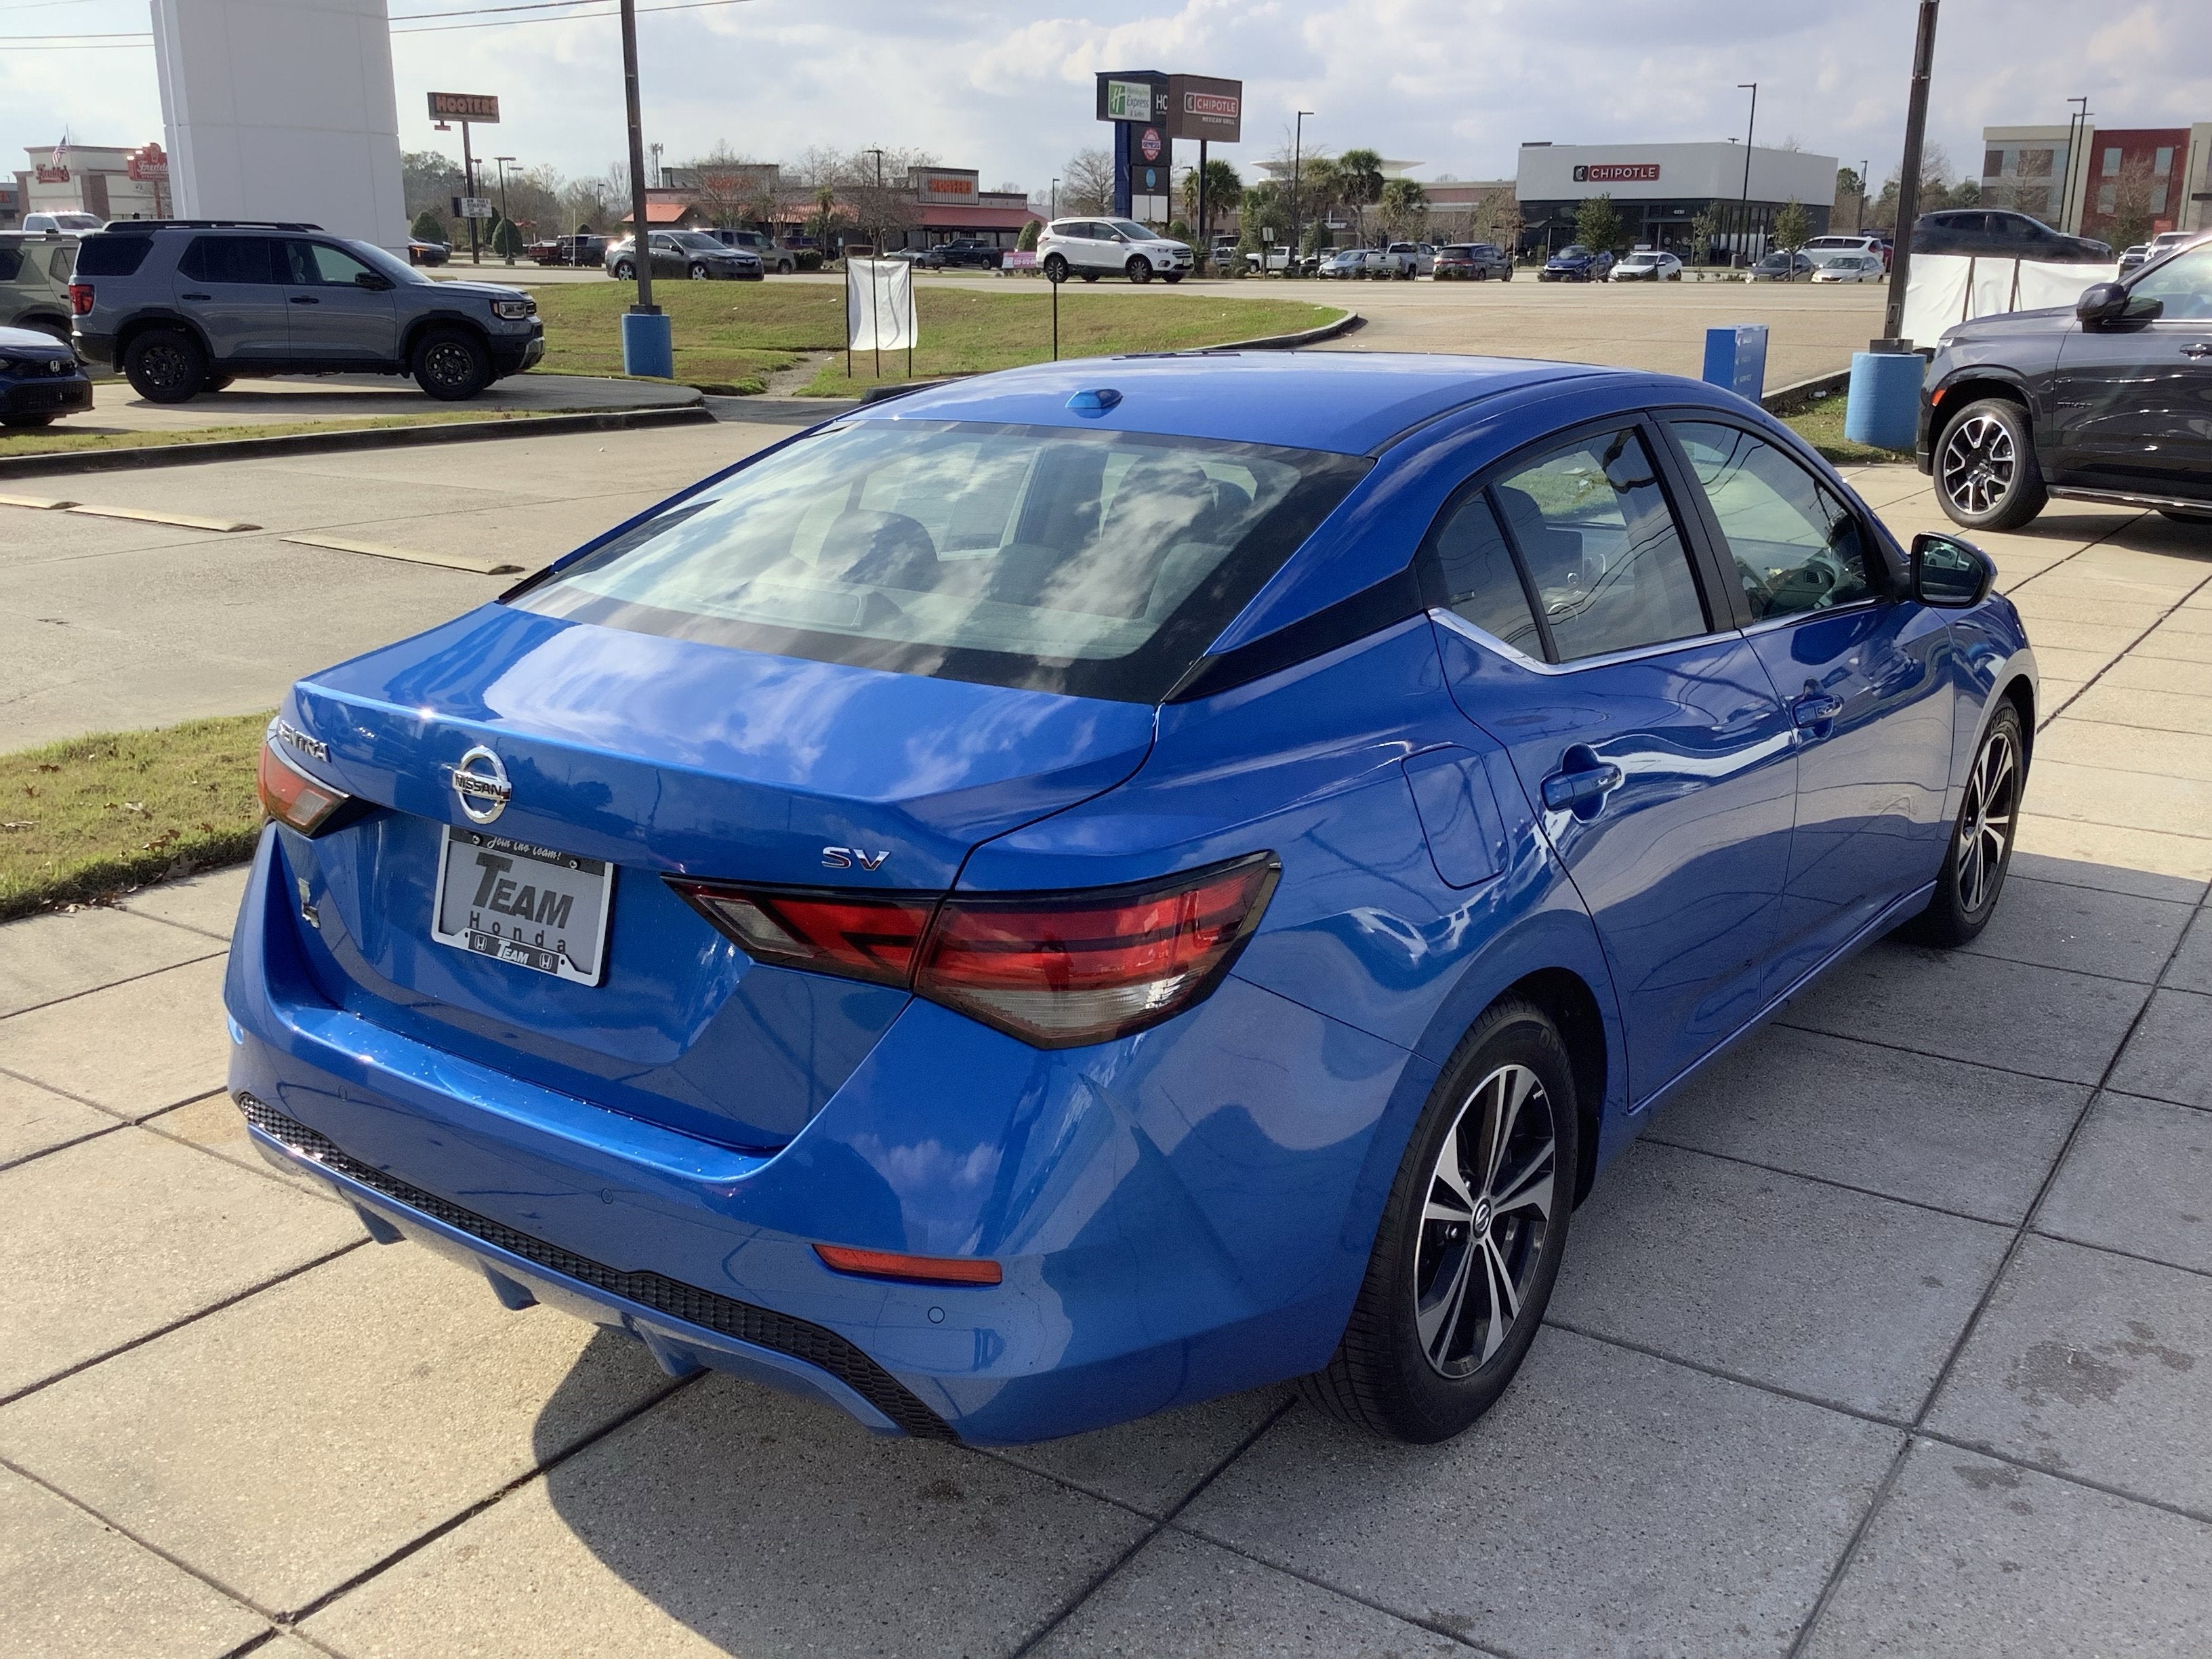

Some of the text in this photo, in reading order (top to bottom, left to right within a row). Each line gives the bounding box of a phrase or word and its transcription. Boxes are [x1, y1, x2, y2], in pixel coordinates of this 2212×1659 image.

[435, 96, 497, 115] HOOTERS
[1126, 95, 1149, 108] Express
[1197, 98, 1236, 112] CHIPOTLE
[1202, 116, 1222, 124] MEXICAN
[1591, 167, 1656, 179] CHIPOTLE
[454, 773, 502, 796] NISSAN
[821, 846, 890, 872] SV
[469, 910, 567, 954] Honda
